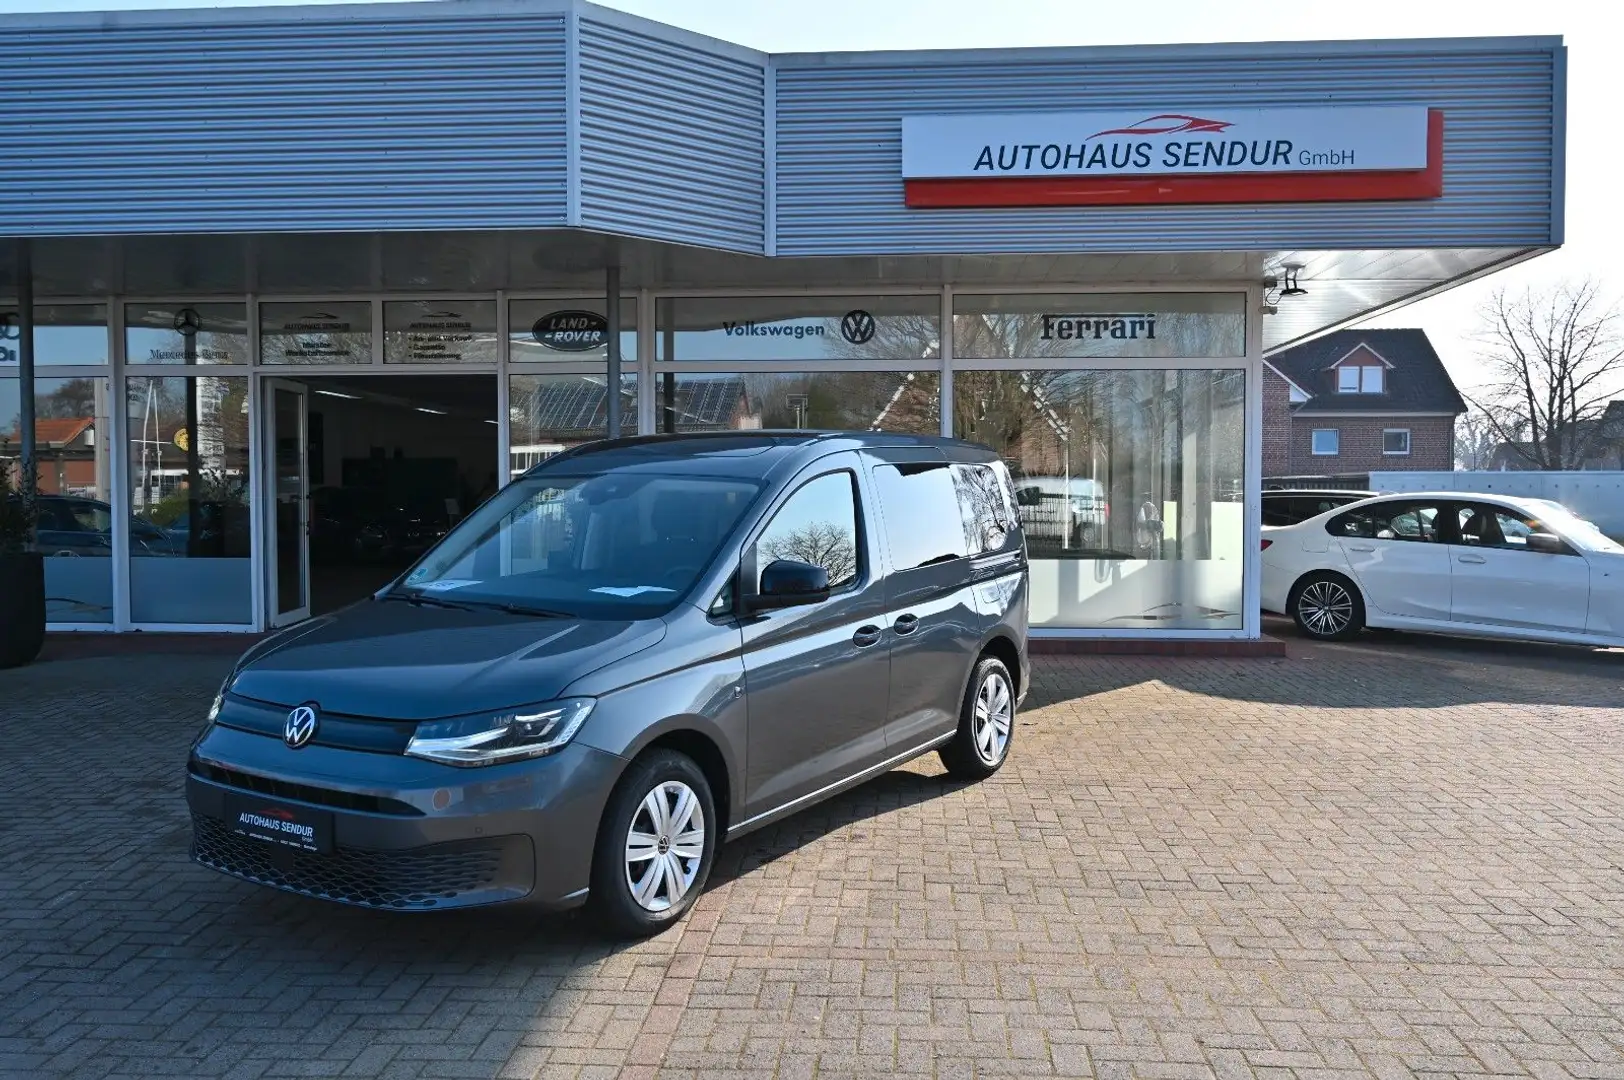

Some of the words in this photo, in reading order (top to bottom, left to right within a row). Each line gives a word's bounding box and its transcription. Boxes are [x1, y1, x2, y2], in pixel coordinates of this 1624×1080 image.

[973, 142, 1152, 171] AUTOHAUS
[1162, 140, 1294, 167] SENDUR
[1298, 149, 1355, 166] GmbH
[722, 321, 825, 339] Volkswagen
[1040, 313, 1157, 341] Ferrari
[239, 812, 281, 830] AUTOHAUS
[281, 821, 314, 838] SENDUR
